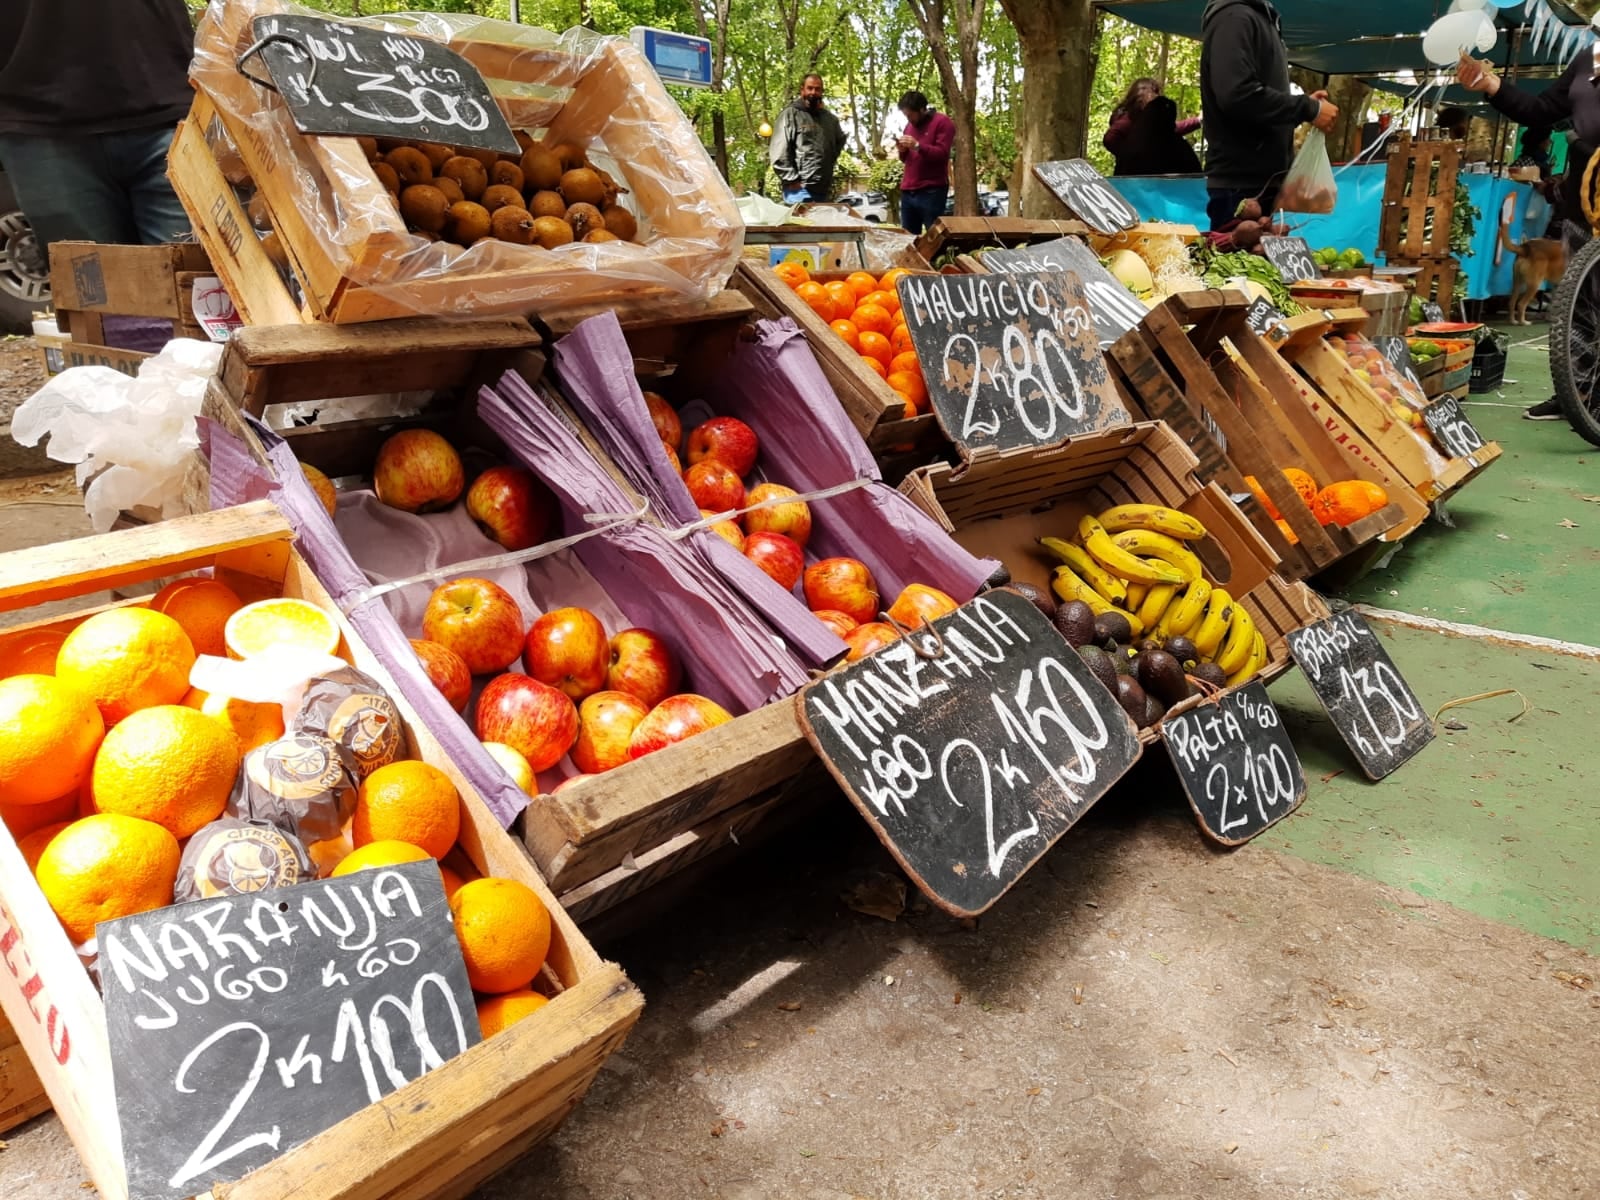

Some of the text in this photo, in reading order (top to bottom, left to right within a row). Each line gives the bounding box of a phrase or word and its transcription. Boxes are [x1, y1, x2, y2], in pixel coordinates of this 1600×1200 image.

[813, 596, 1031, 761] MANZANA
[227, 828, 282, 846] CITRUS
[105, 871, 423, 993] NARANJA
[134, 966, 289, 1031] JUGO
